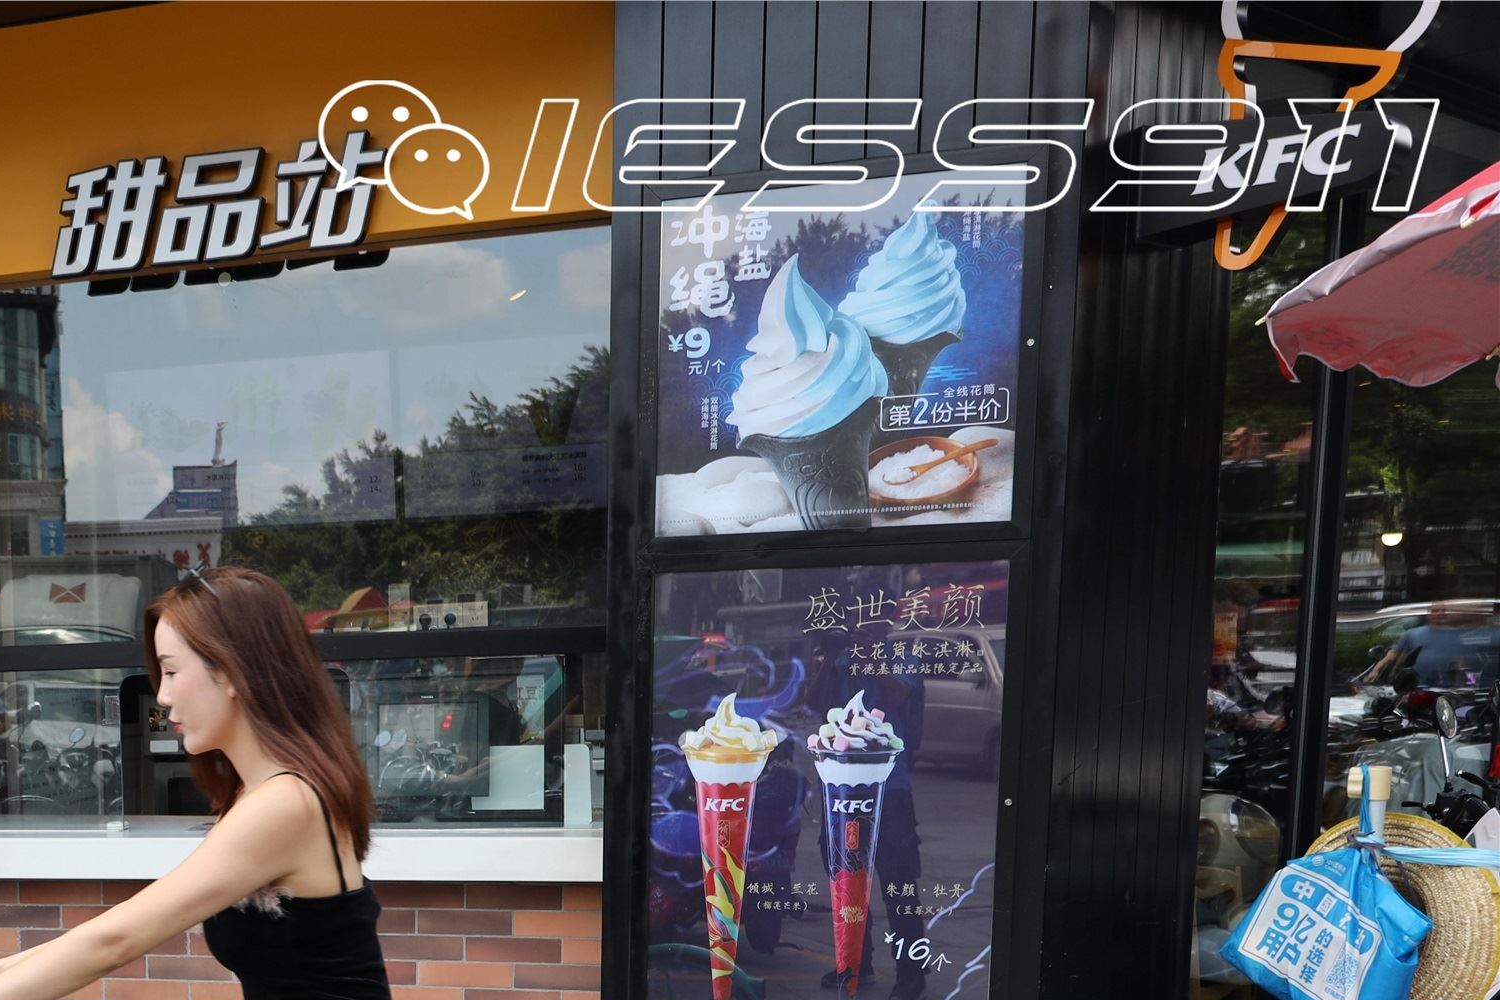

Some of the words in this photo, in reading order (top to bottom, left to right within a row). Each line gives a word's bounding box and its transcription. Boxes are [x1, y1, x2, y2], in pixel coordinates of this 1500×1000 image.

[1190, 123, 1361, 196] KFC
[51, 131, 388, 278] 甜品站
[670, 204, 736, 318] 冲绳
[734, 209, 772, 281] 海盐
[668, 327, 711, 359] ¥9
[688, 359, 727, 377] 元/个
[943, 384, 996, 399] 全线花筒
[888, 397, 1002, 427] 第2份半价
[803, 583, 986, 635] 盛世美颜
[849, 641, 976, 661] 大花筒冰淇淋
[848, 662, 983, 677] 肯德基甜品站限定产品
[704, 797, 746, 812] KFC
[831, 798, 875, 813] KFC
[1255, 926, 1303, 967] 用户
[1299, 928, 1335, 985] 的选择
